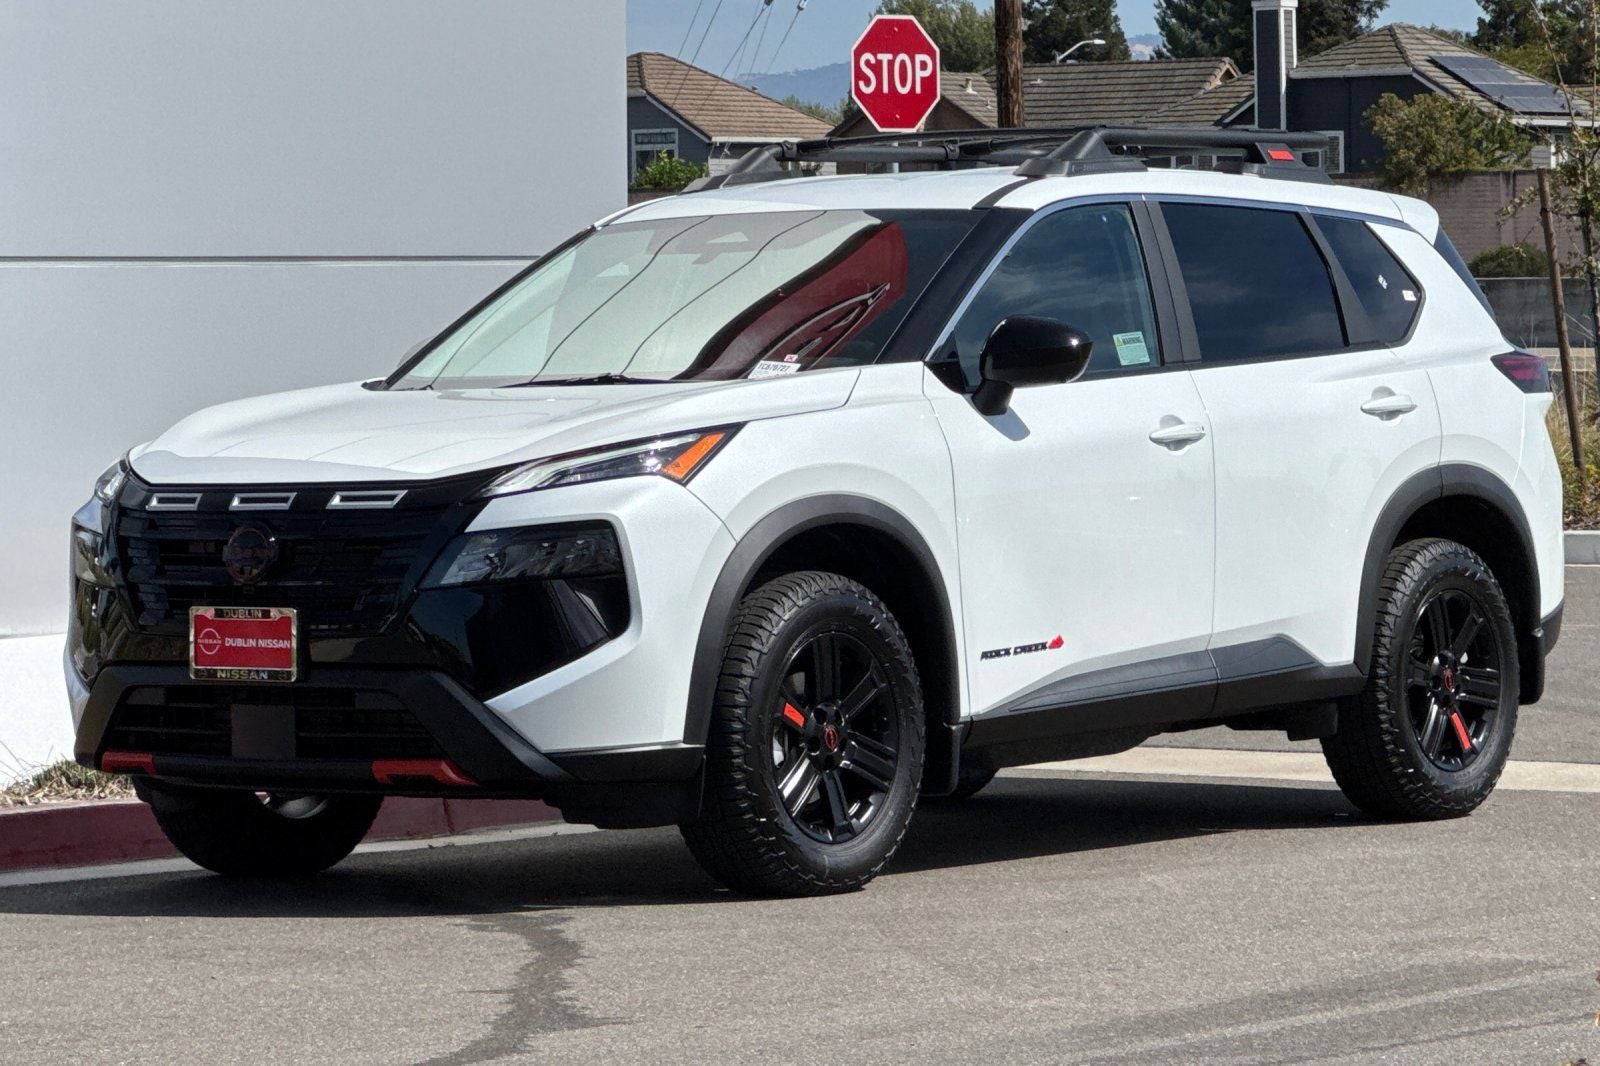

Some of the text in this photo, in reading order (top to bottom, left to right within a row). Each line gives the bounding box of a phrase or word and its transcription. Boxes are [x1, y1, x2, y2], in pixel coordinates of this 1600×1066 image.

[858, 52, 933, 94] STOP
[223, 609, 262, 618] DUBLIN
[225, 637, 291, 649] DUBLIN NISSAN
[980, 641, 1048, 660] ROCK CREEK
[217, 669, 268, 679] NISSAN
